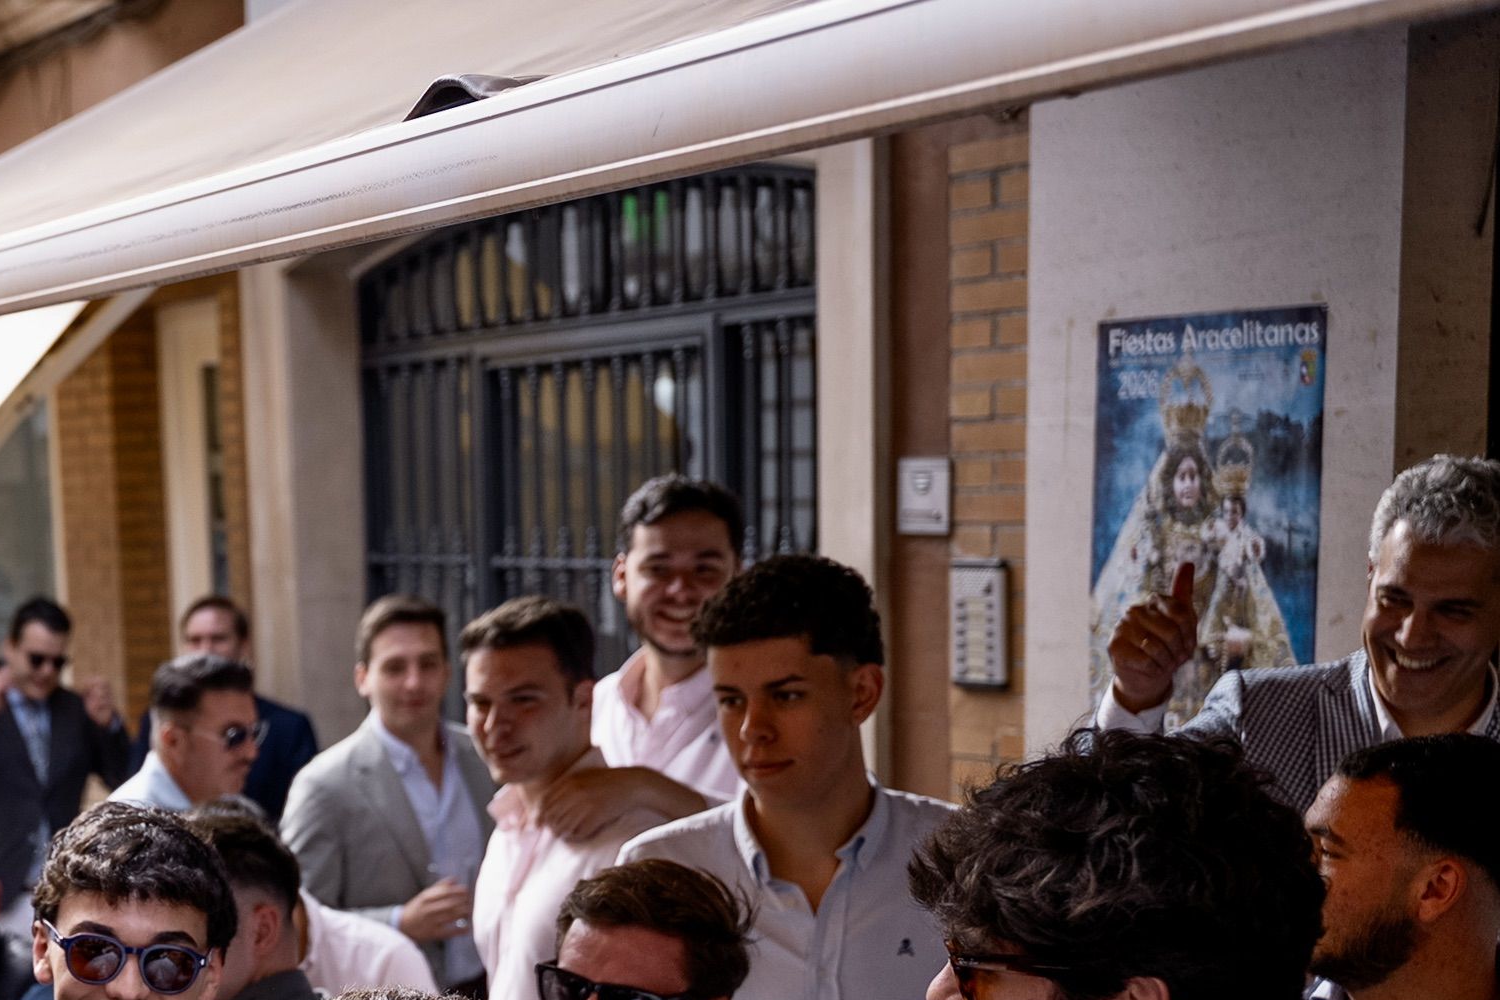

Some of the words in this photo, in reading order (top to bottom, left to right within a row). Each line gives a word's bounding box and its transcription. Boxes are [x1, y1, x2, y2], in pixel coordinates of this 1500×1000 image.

[1107, 327, 1176, 357] Fiestas
[1181, 318, 1320, 352] Aracelitanas
[1117, 370, 1160, 400] 2026
